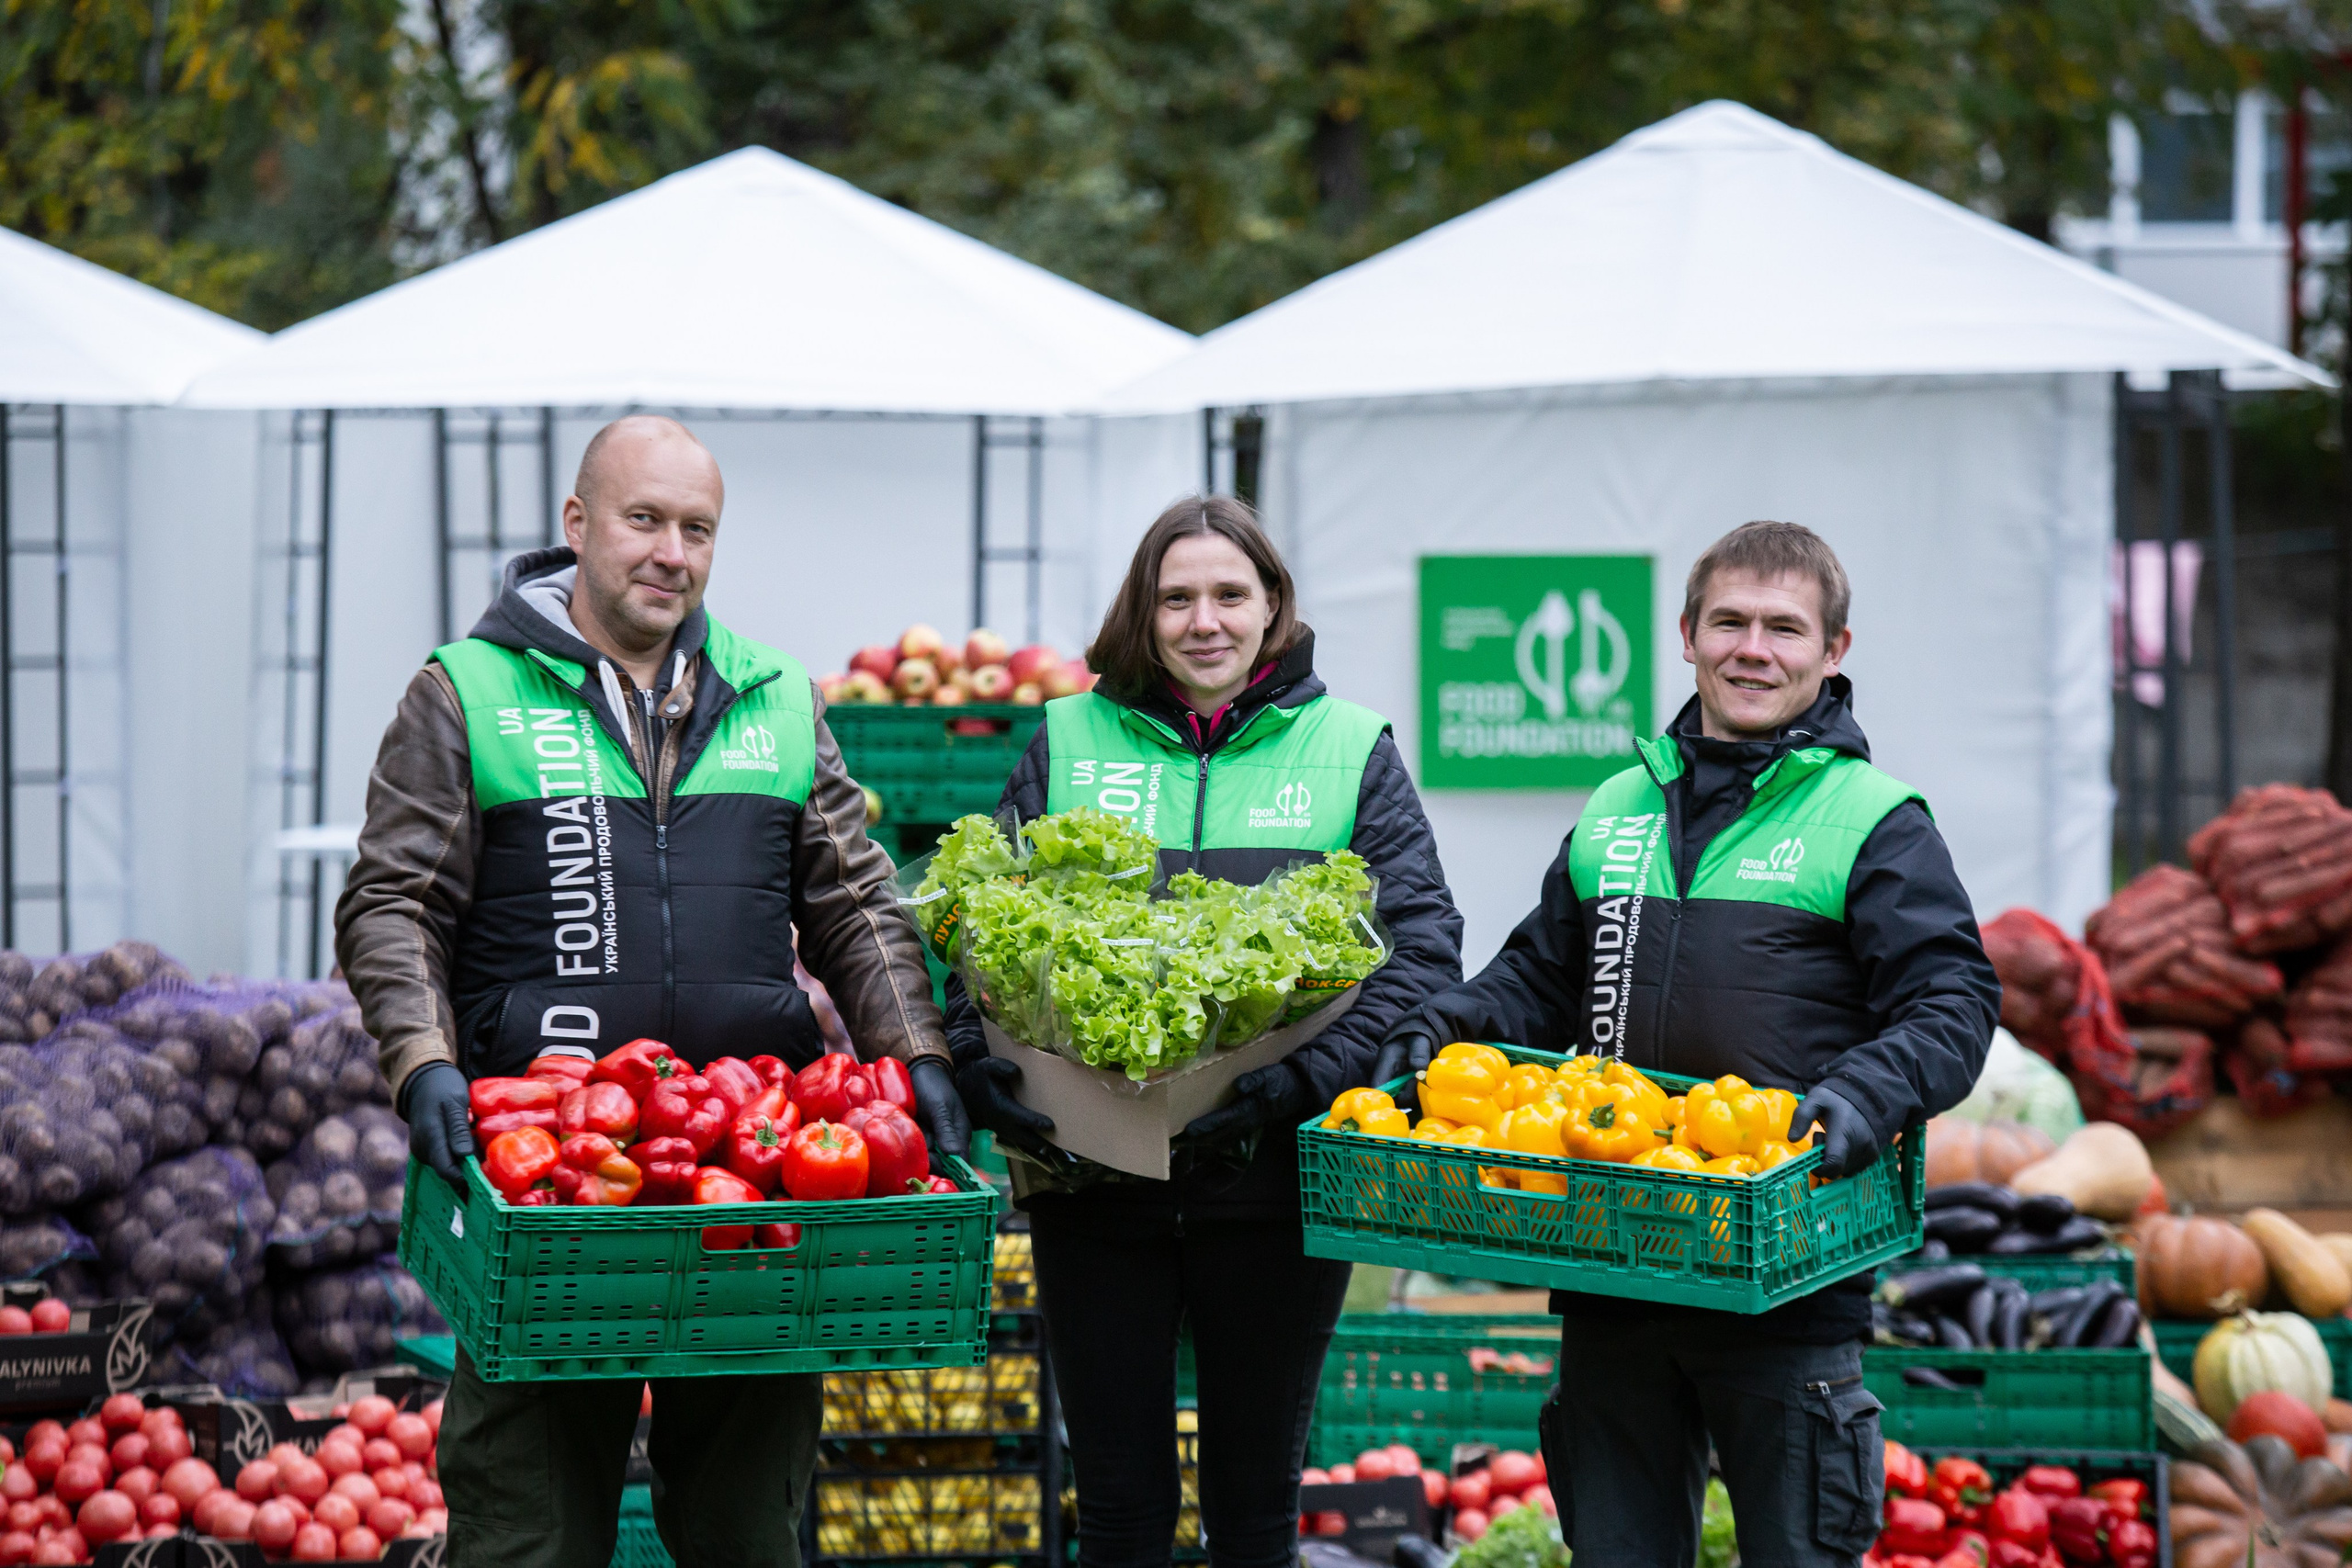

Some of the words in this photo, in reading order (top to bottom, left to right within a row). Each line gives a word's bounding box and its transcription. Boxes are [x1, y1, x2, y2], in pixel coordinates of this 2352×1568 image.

[497, 707, 525, 735] UA
[577, 709, 595, 747] ФОНД
[720, 750, 747, 760] FOOD
[722, 760, 779, 773] FOUNDATION
[1070, 760, 1097, 784] UA
[1148, 763, 1163, 801] ФОНД
[583, 750, 612, 867] ПРОДОВОЛЬЧИЙ
[1250, 808, 1276, 818] FOOD
[1249, 818, 1311, 829] FOUNDATION
[1590, 816, 1619, 840] UA
[528, 708, 600, 976] FOUNDATION
[1736, 869, 1797, 884] FOUNDATION
[1740, 858, 1767, 871] FOOD
[1623, 852, 1654, 964] ПРОДОВОЛЬЧИЙ
[597, 871, 618, 974] УКРАЇНСЬКИЙ
